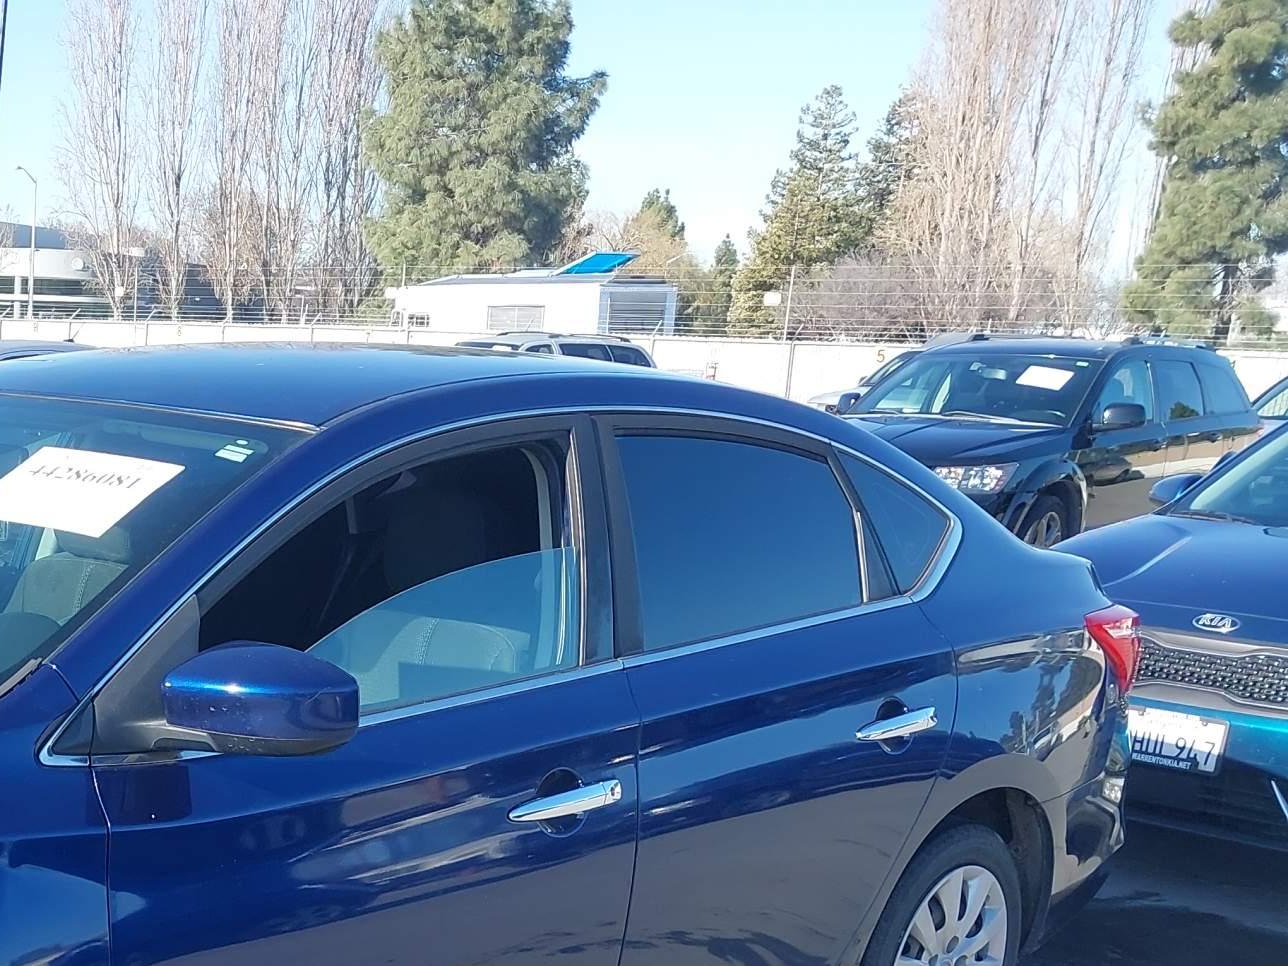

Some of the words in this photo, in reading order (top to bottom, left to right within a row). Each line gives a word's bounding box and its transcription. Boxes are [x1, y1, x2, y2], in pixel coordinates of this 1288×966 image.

[876, 349, 886, 363] 5
[28, 465, 142, 489] 44286081
[1197, 614, 1233, 629] KIA
